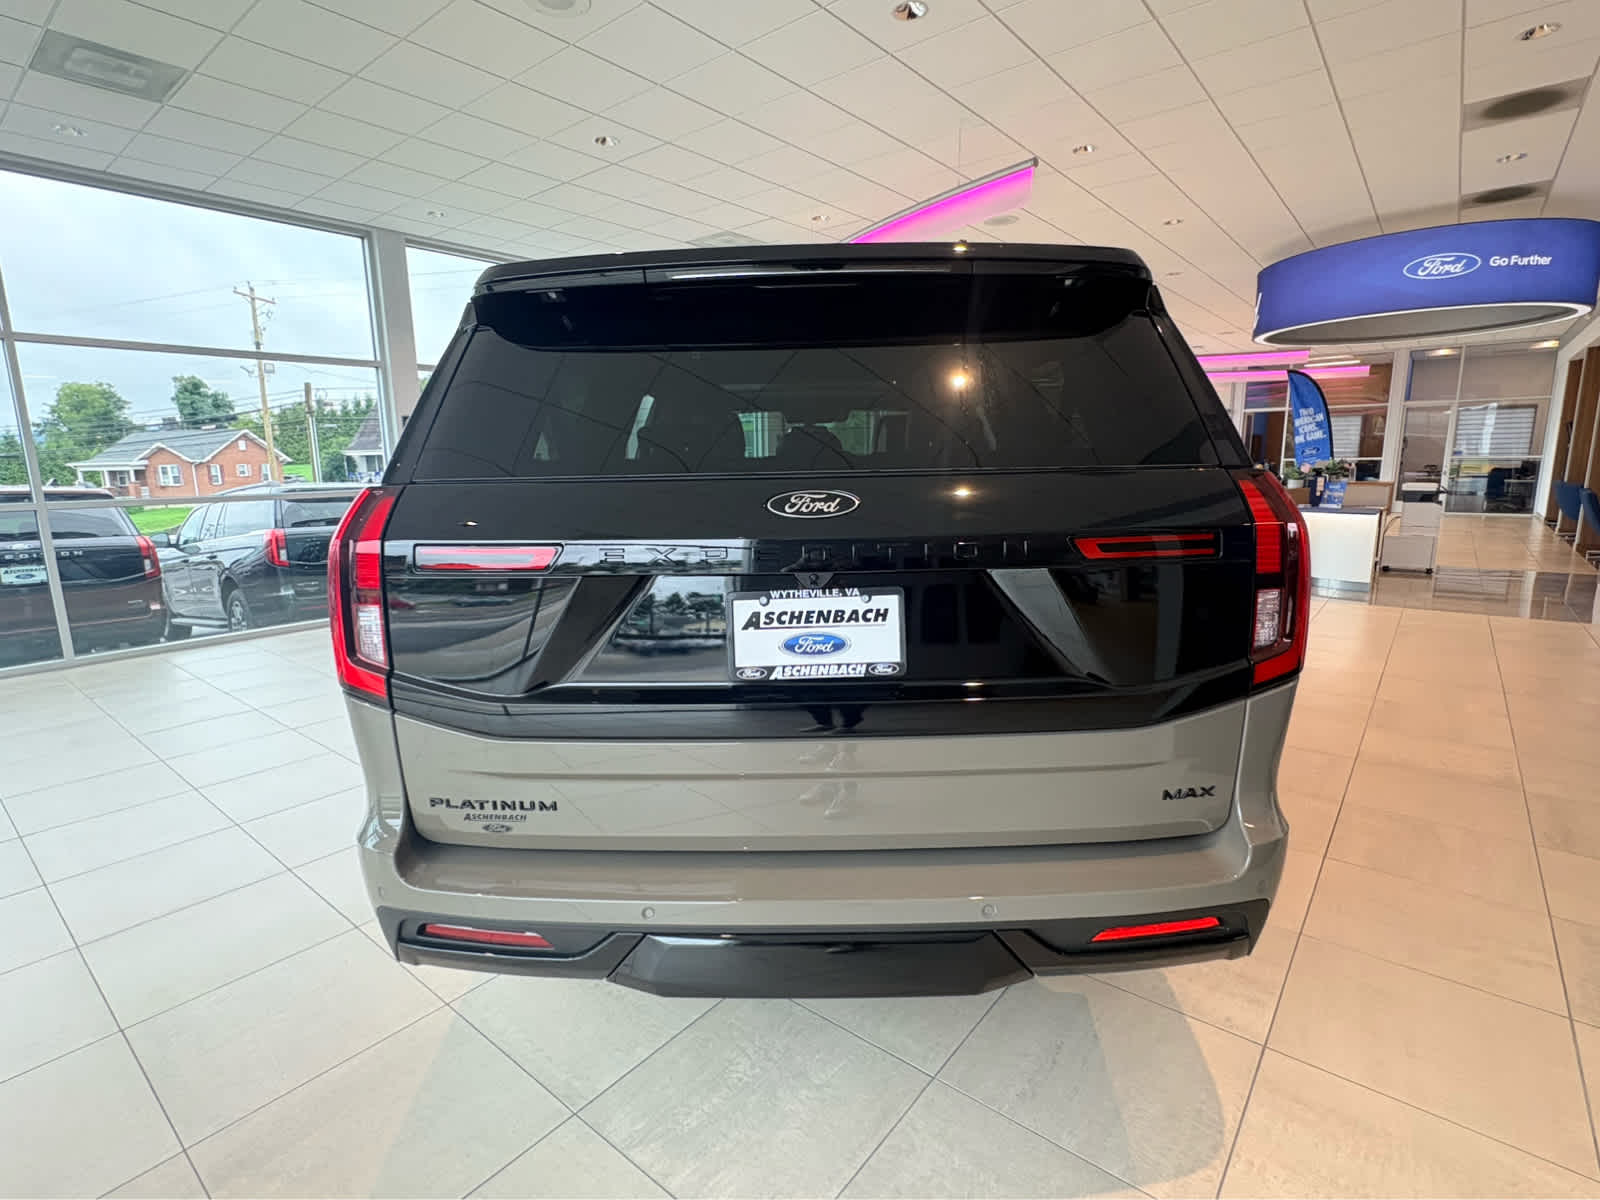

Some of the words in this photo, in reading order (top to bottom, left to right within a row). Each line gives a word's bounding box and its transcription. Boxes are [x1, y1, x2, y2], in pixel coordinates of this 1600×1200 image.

[1418, 257, 1467, 276] Ford
[1489, 256, 1508, 266] Go
[1510, 254, 1552, 266] Further
[785, 494, 840, 513] Ford
[598, 538, 1032, 566] EXPEDITION
[845, 588, 860, 597] VA
[741, 608, 889, 631] ASCHENBACH
[794, 636, 834, 653] Ford
[769, 664, 867, 680] ASCHENBACH
[1162, 785, 1216, 800] MAX
[429, 797, 558, 811] PLATINUM
[463, 813, 527, 822] ASCHENBACH
